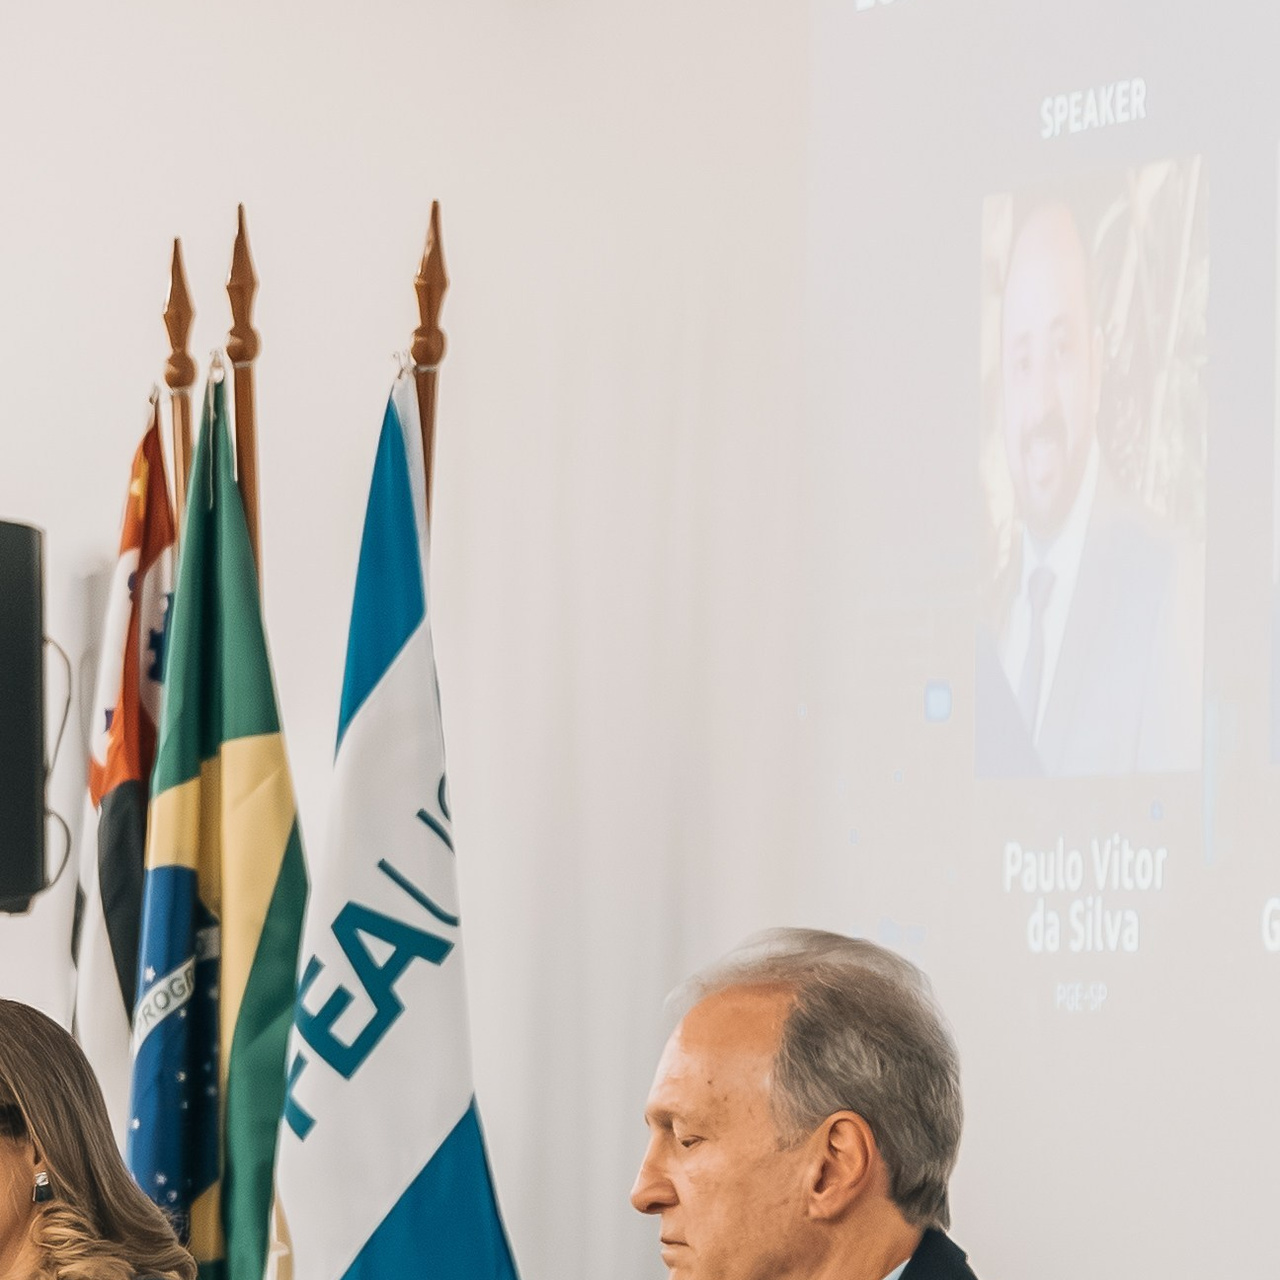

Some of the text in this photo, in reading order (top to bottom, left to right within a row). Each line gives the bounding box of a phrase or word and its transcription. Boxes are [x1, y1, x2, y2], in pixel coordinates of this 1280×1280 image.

[1041, 78, 1147, 139] SPEAKER
[1004, 832, 1167, 892] Paulo Vitor
[1027, 895, 1140, 952] da Silva
